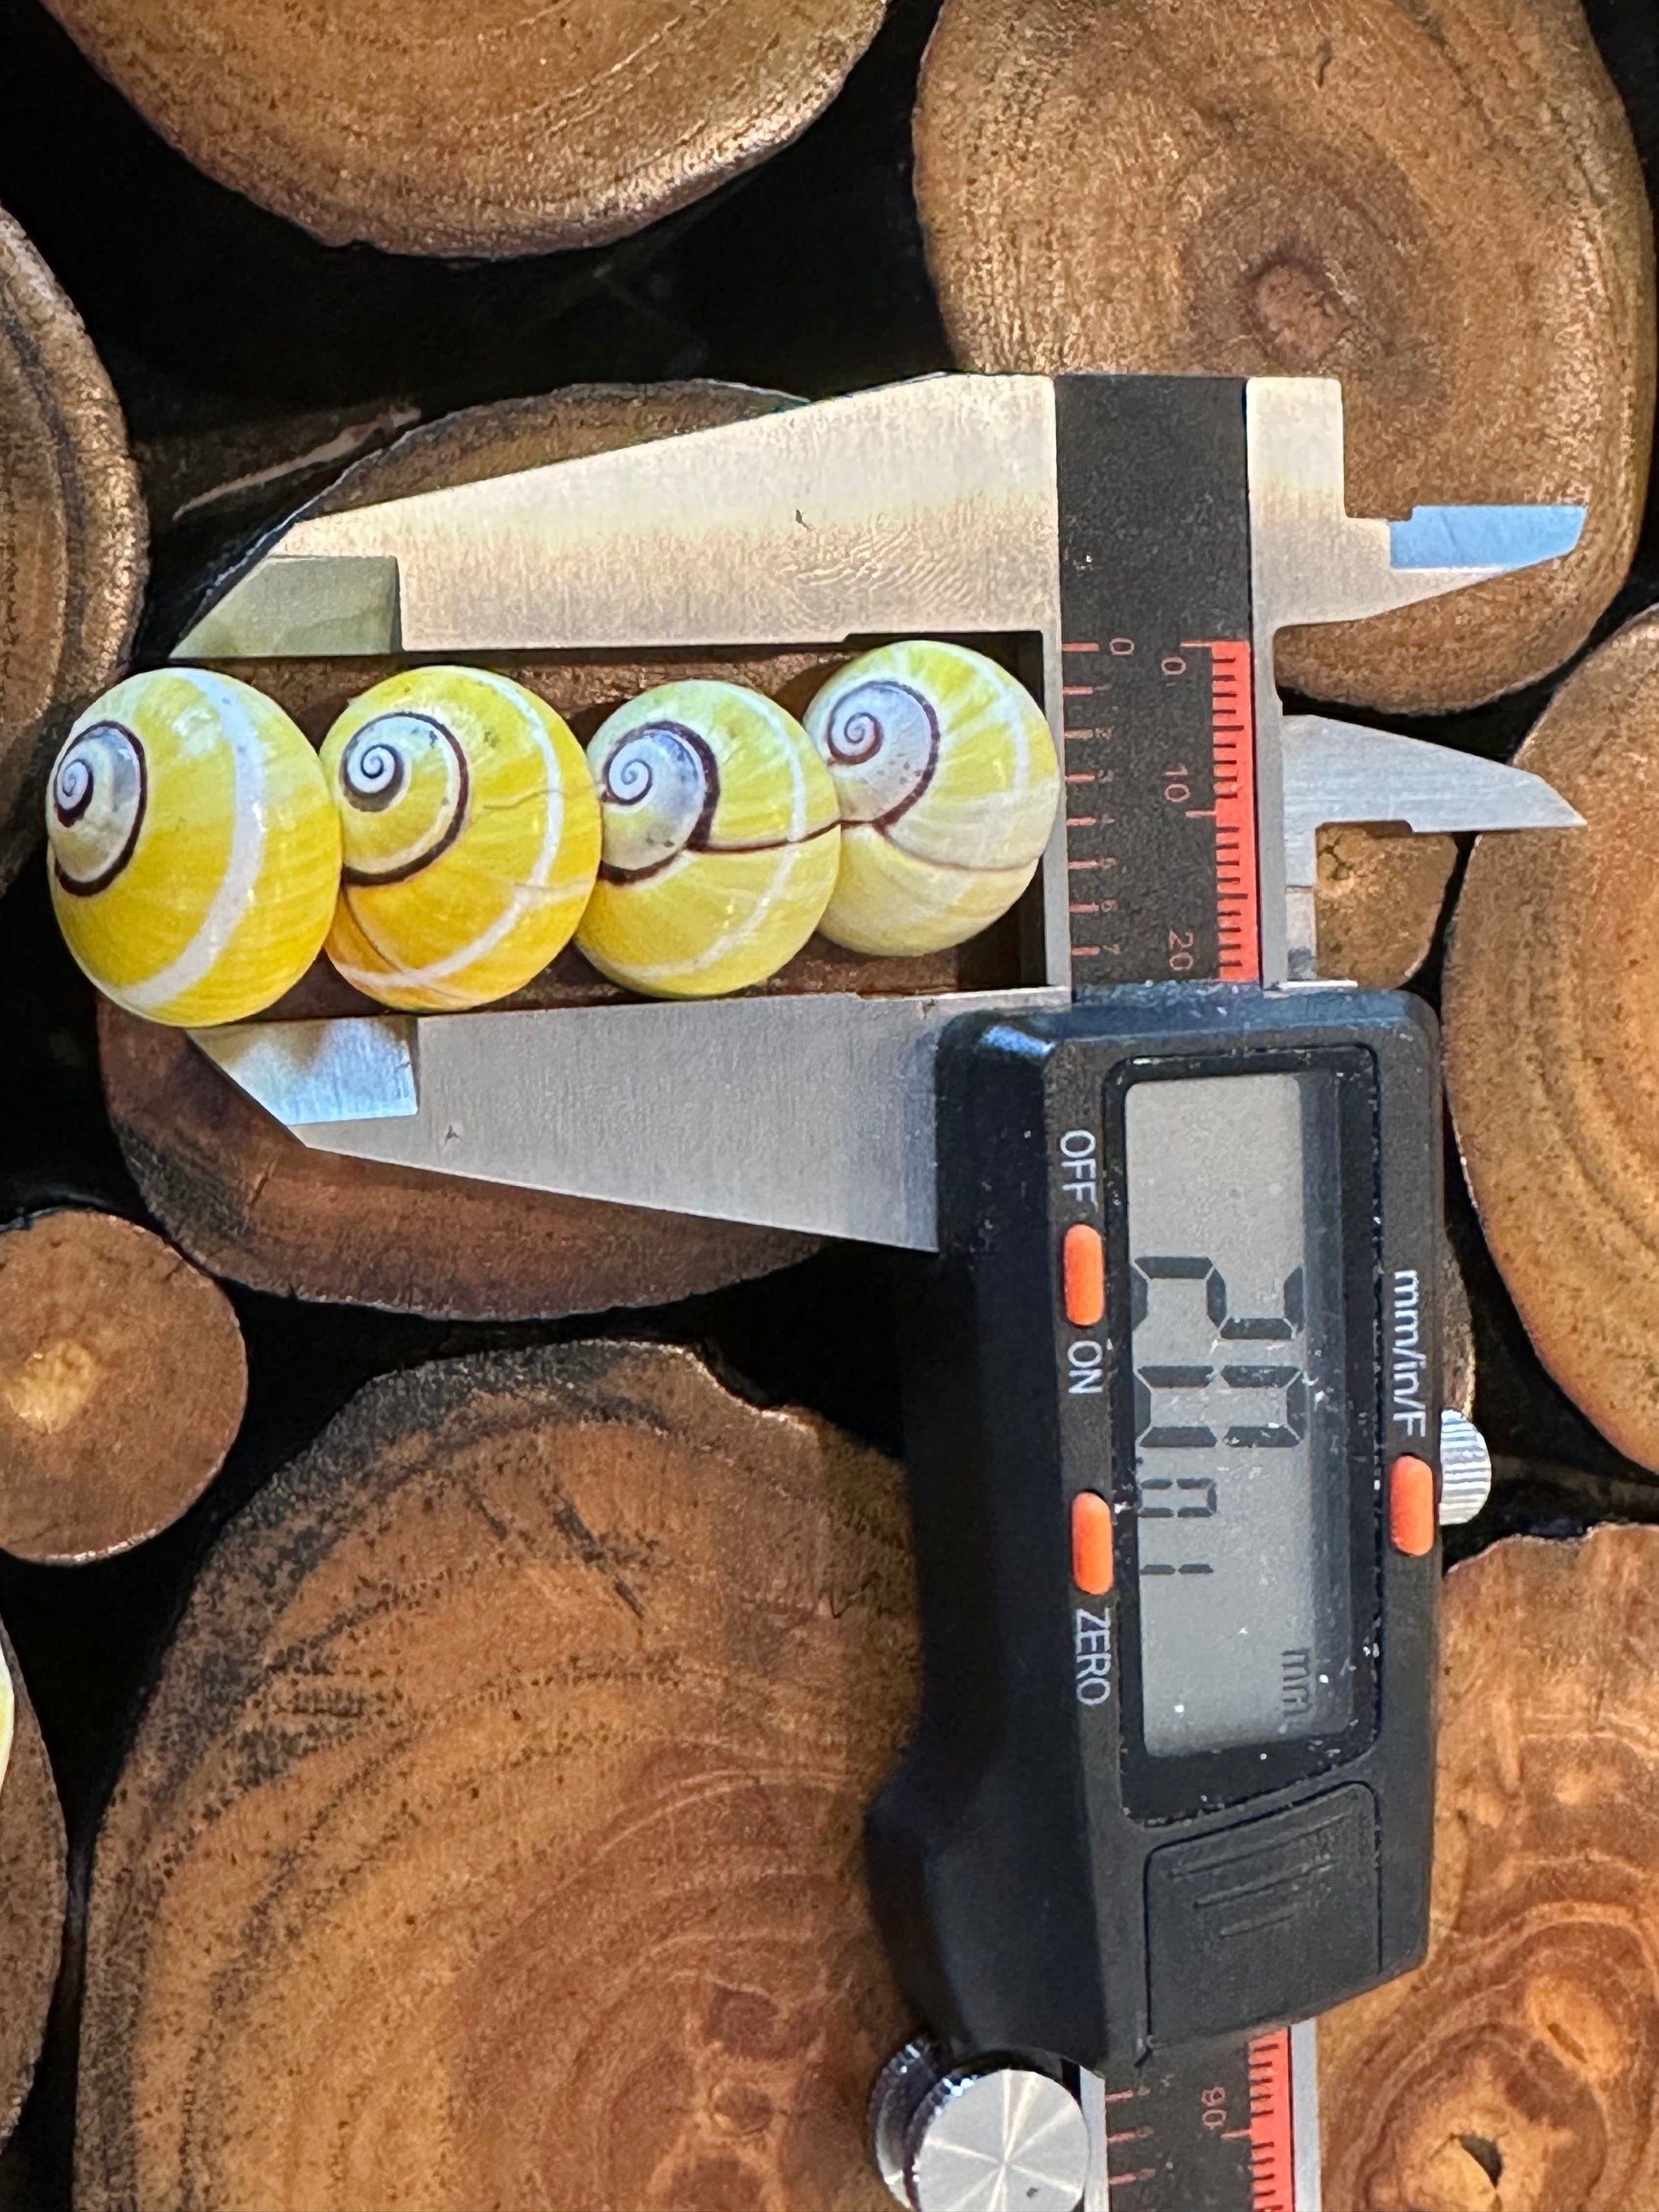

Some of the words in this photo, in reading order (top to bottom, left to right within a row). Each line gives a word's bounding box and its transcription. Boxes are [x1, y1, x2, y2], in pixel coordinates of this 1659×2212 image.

[1109, 638, 1135, 656] 0
[1160, 656, 1187, 676] 0
[1164, 763, 1191, 803] 10
[1168, 930, 1194, 971] 20
[1059, 1129, 1099, 1210] OFF
[1067, 1340, 1104, 1395] ON
[1393, 1269, 1428, 1439] mm/in/F
[1075, 1607, 1112, 1707] ZERO
[1280, 1647, 1313, 1719] mm
